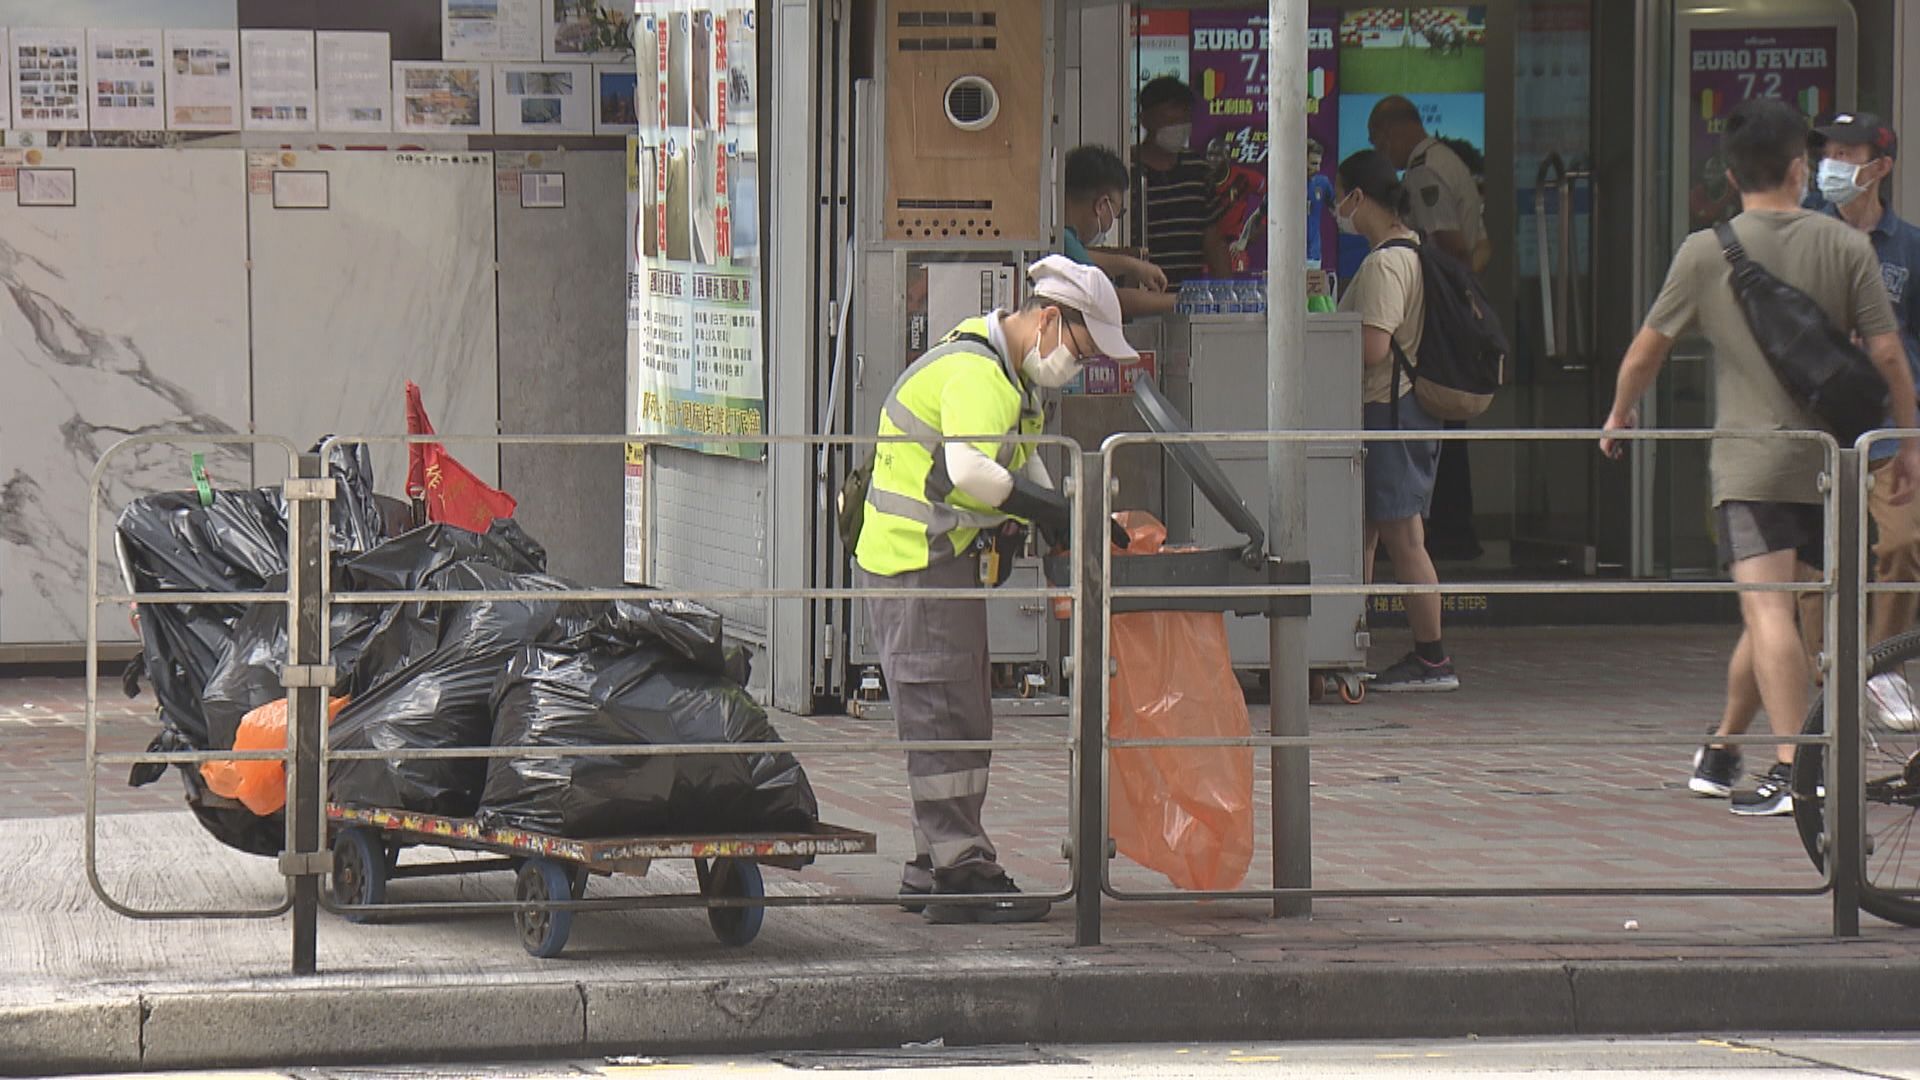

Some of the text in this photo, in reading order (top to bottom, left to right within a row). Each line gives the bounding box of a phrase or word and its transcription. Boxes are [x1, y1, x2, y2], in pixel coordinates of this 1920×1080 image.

[1193, 28, 1334, 50] EURO FER
[1240, 53, 1268, 81] 7.
[1692, 47, 1828, 70] EURO FEVER
[1738, 73, 1782, 99] 7.2
[1458, 595, 1488, 610] STEPS
